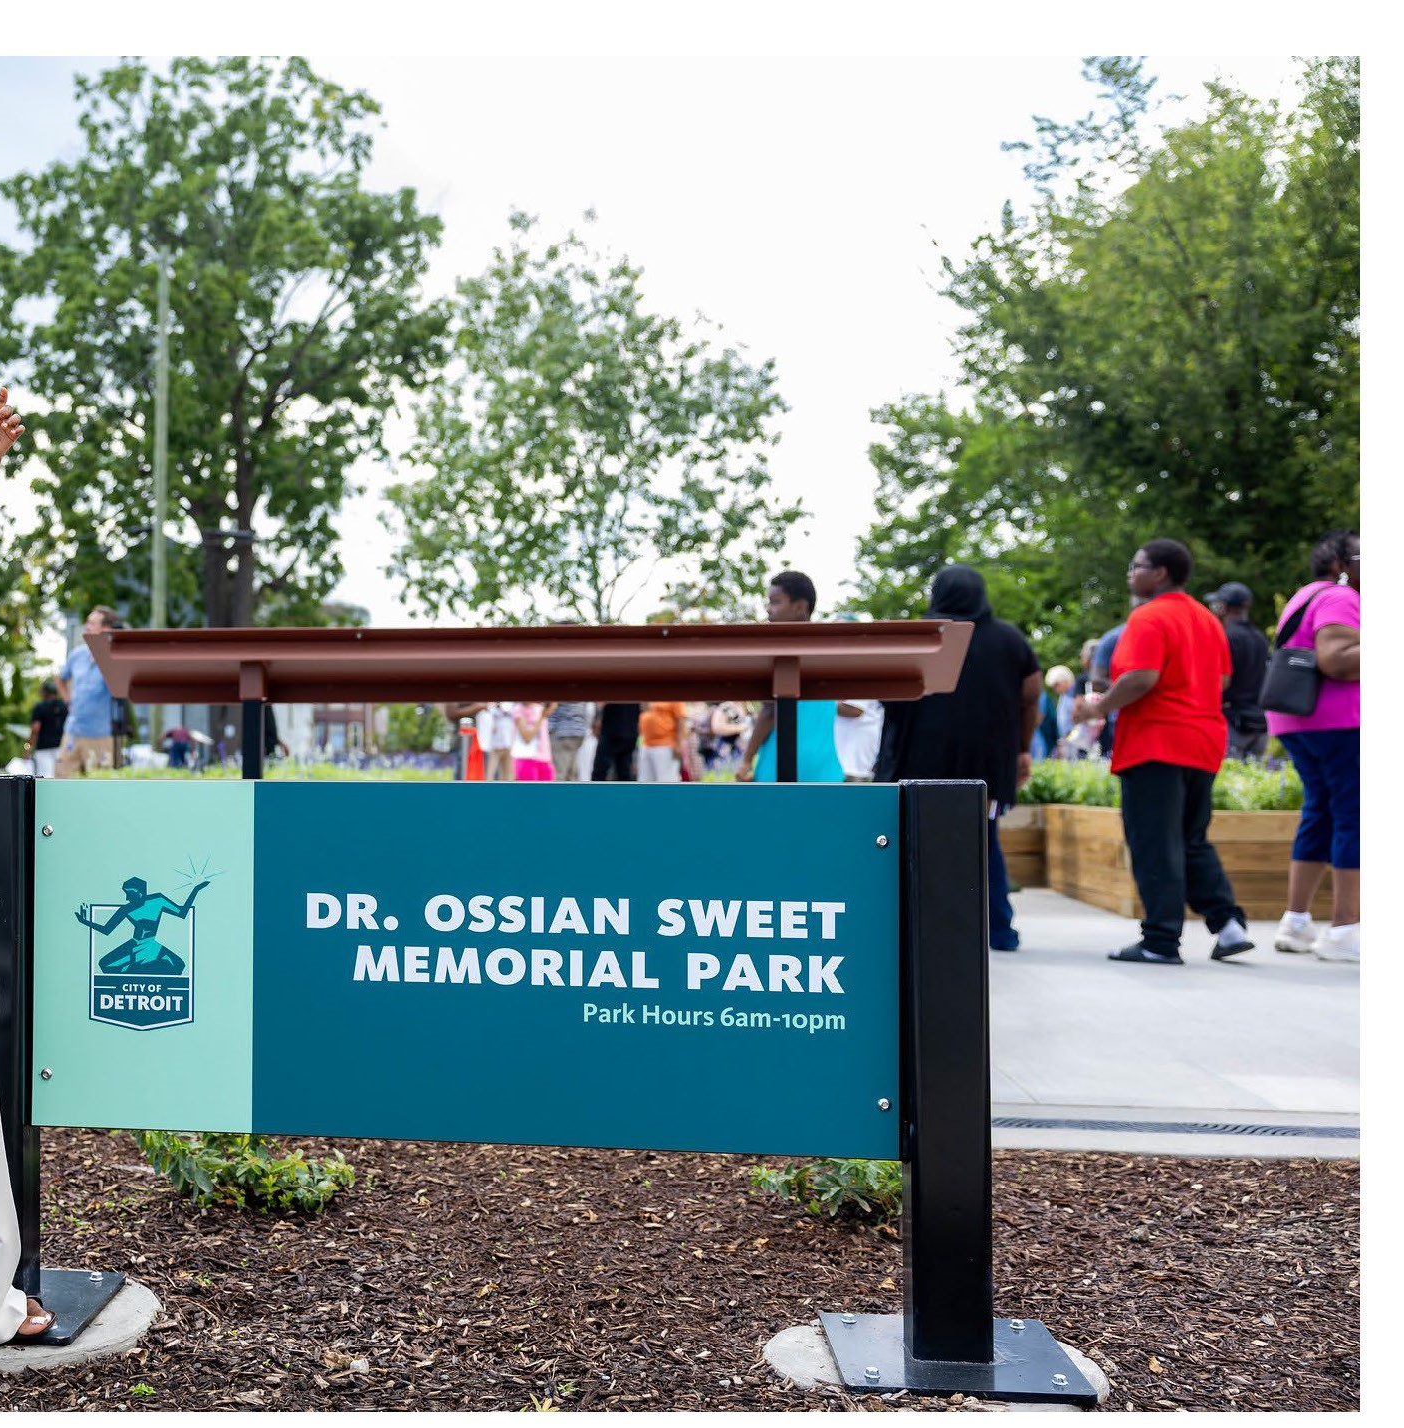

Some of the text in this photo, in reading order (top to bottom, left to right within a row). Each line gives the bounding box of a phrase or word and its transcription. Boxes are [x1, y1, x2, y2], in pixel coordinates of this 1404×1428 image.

[307, 893, 846, 940] DR. OSSIAN SWEET
[352, 944, 845, 994] MEMORIAL PARK
[100, 994, 184, 1011] DETROIT
[122, 983, 162, 993] CITY OF
[583, 1002, 846, 1034] Park Hours 6am-10pm
